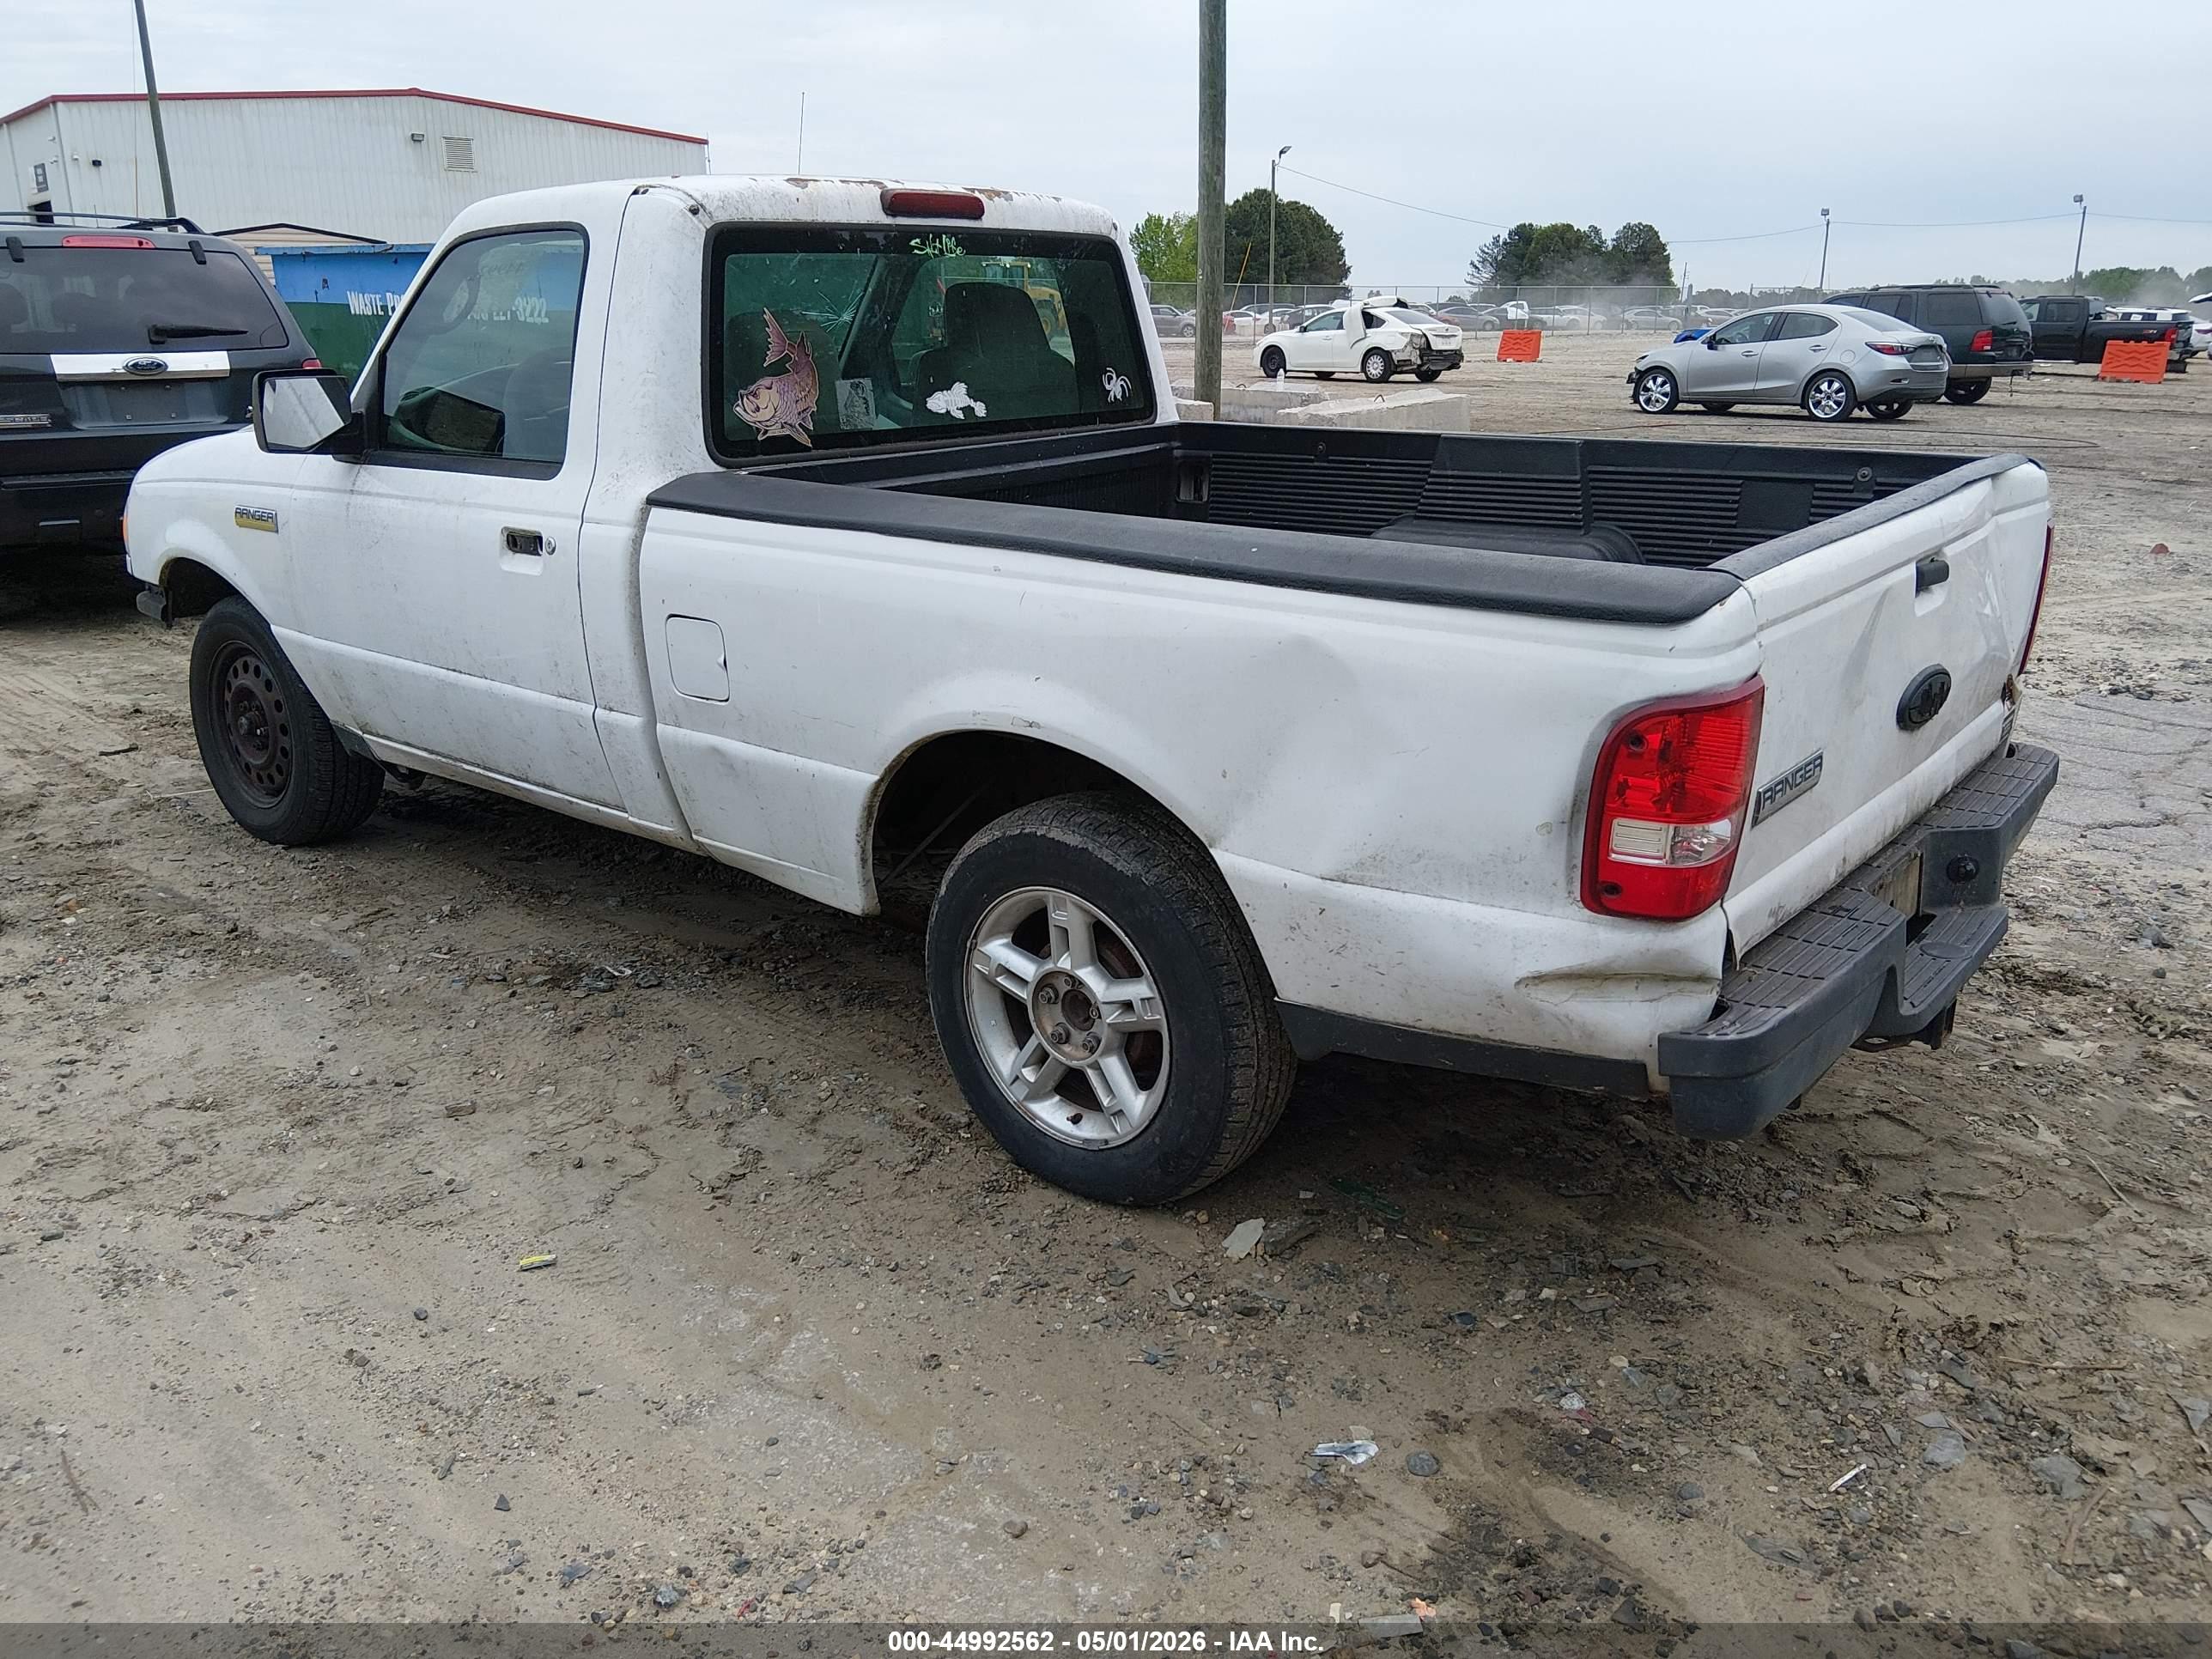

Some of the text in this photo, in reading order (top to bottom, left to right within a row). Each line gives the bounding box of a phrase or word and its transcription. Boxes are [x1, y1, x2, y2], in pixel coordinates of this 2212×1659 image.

[347, 290, 384, 316] WASTE
[234, 507, 274, 523] RANGER
[1761, 755, 1823, 811] RANGER
